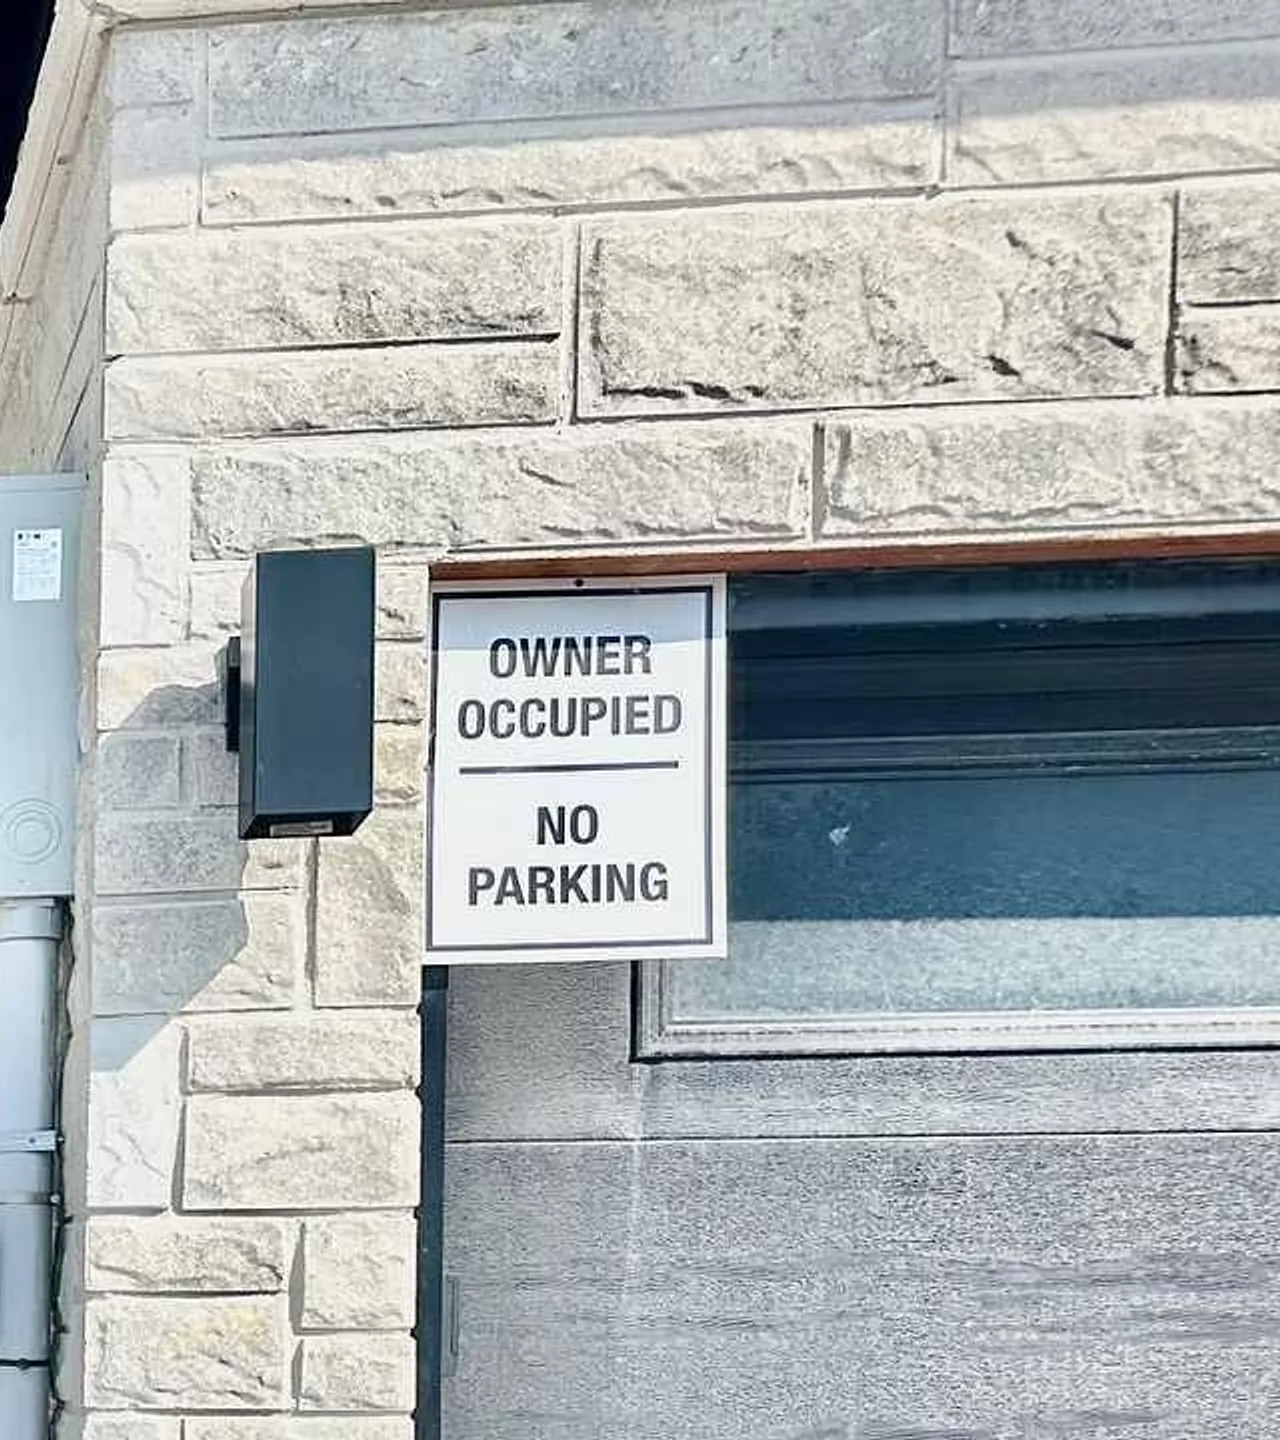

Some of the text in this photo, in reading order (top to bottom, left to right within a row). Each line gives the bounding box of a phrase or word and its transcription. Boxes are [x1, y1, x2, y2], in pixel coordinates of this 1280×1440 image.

[488, 635, 652, 678] OWNER
[458, 694, 682, 739] OCCUPIED
[537, 804, 599, 845] NO
[468, 862, 669, 906] PARKING
